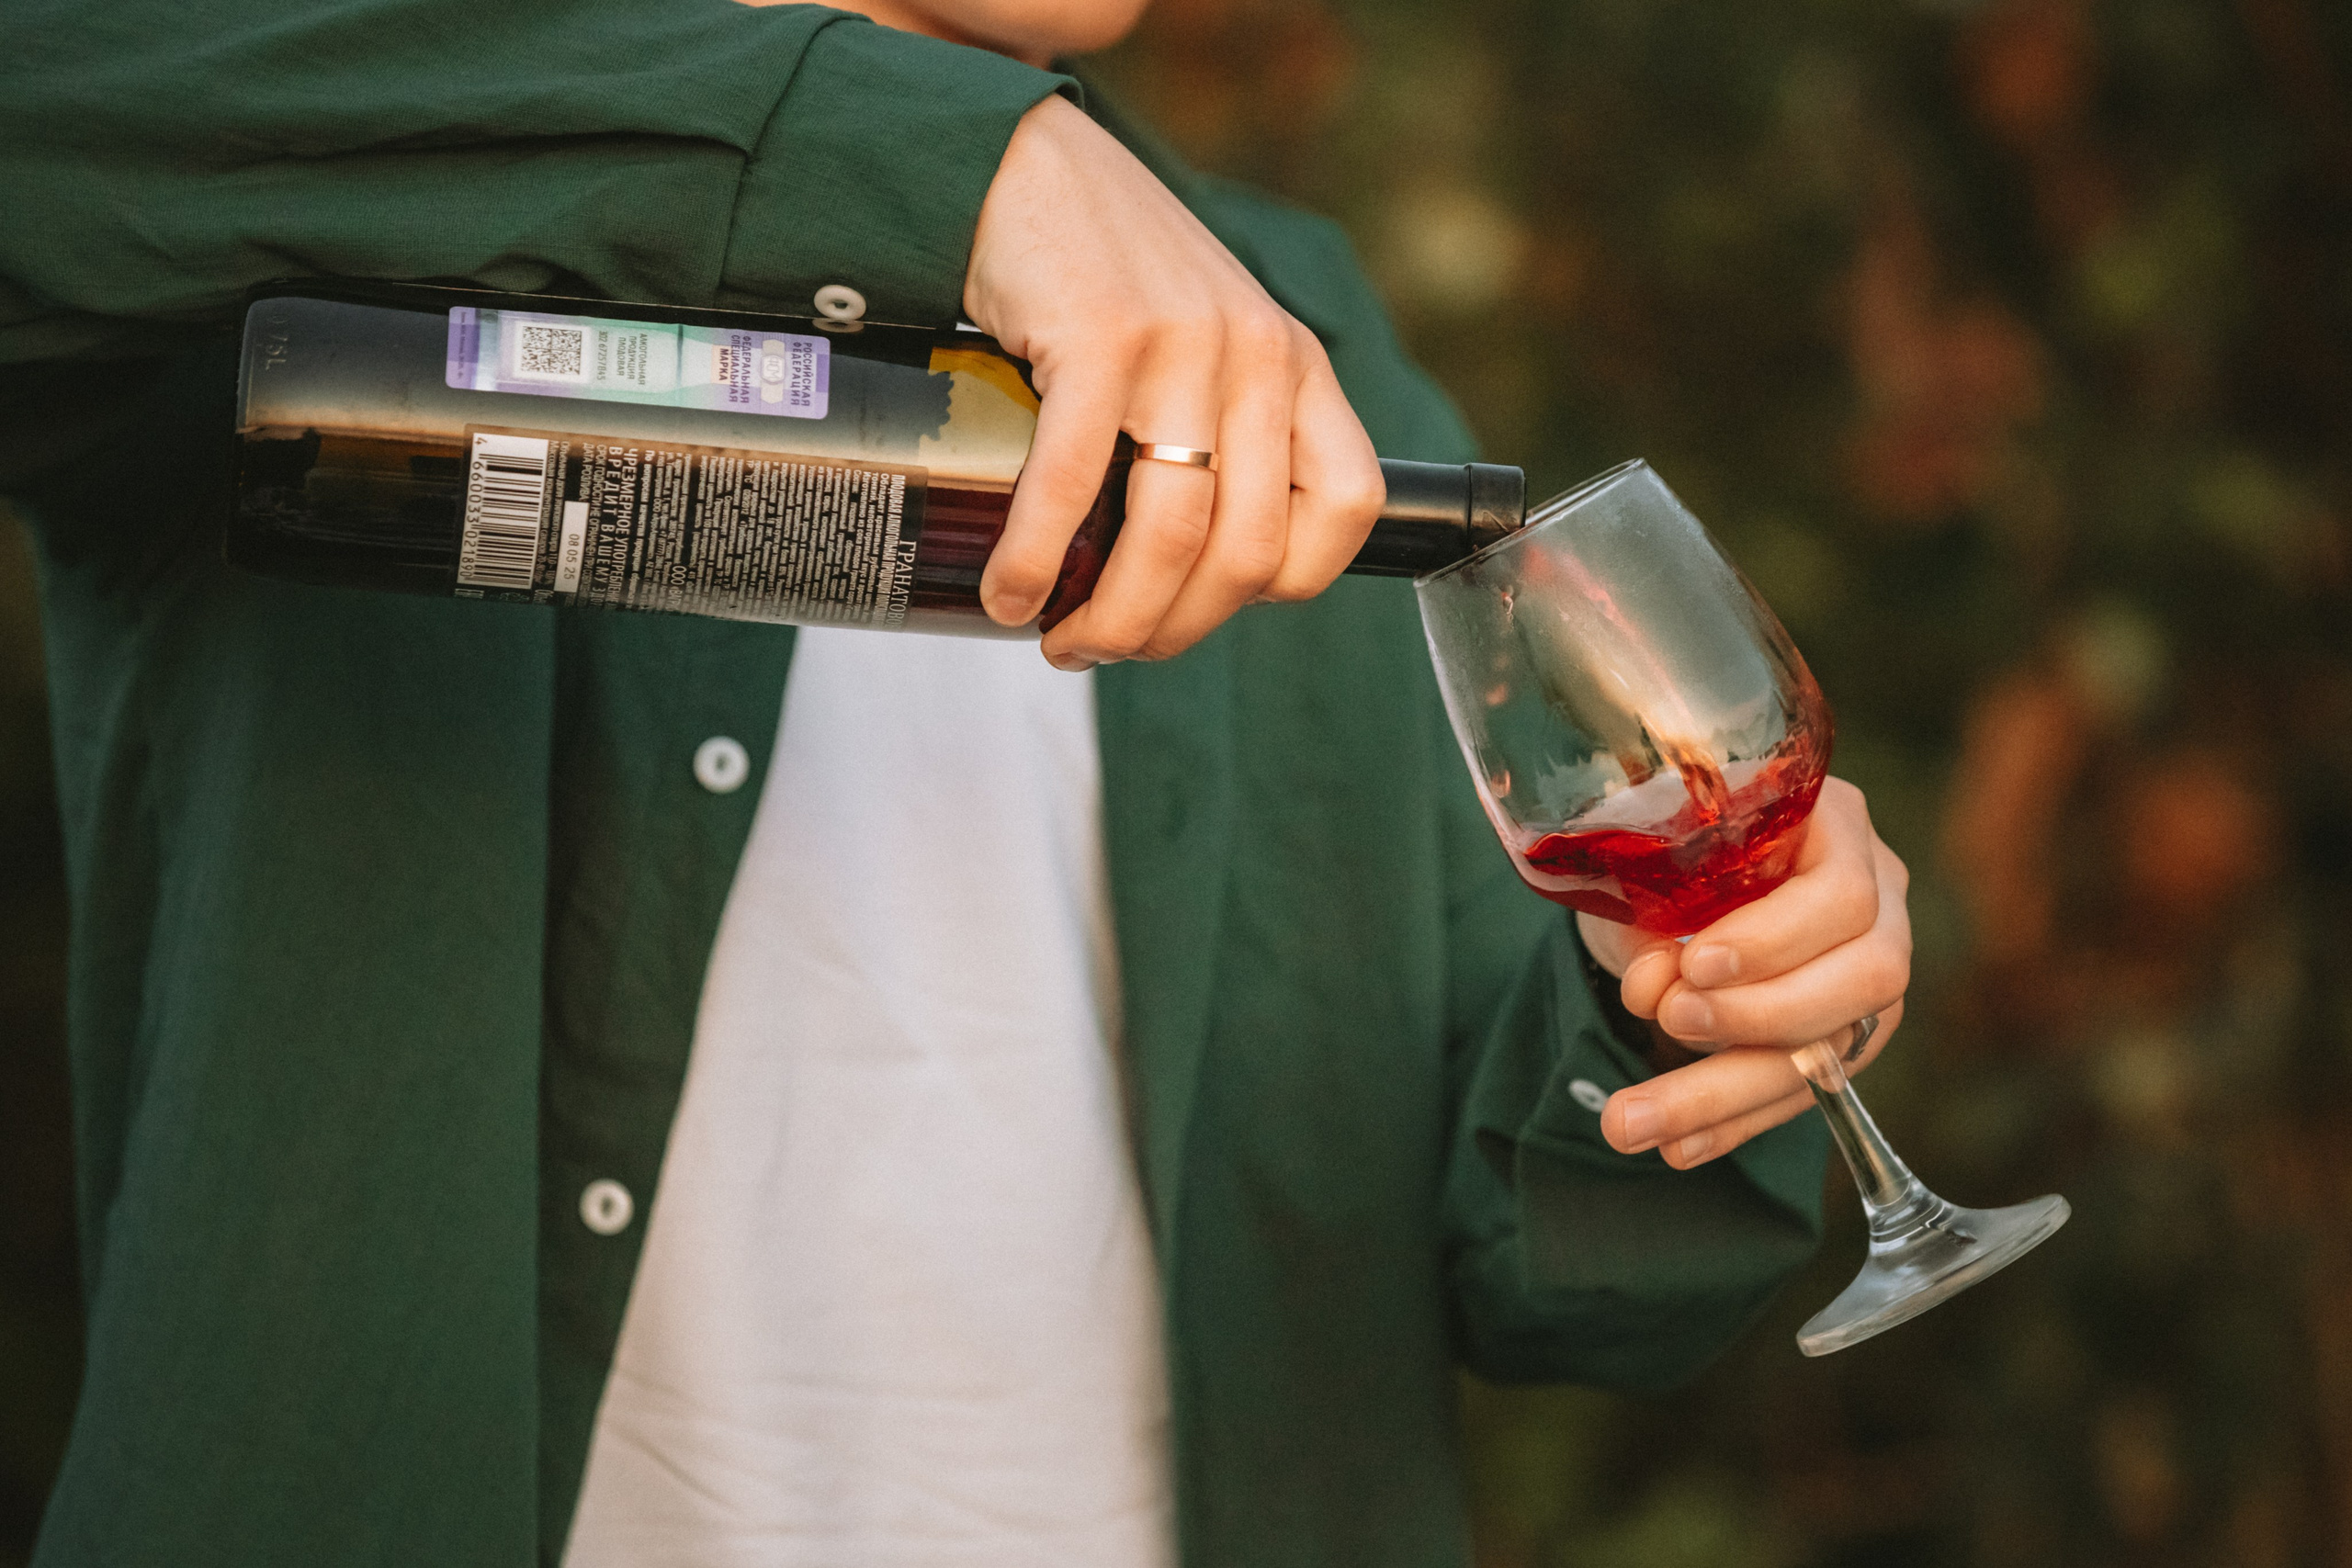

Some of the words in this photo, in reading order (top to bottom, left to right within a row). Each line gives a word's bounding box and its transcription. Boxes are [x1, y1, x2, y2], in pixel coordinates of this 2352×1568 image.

[616, 336, 626, 376] ПЛОДОВАЯ
[627, 335, 636, 379] ПРОДУКЦИЯ
[638, 333, 647, 385] АЛКОГОЛЬНАЯ
[718, 348, 728, 380] МАРКА
[728, 334, 740, 402] СПЕЦИАЛЬНАЯ
[740, 335, 751, 403] ФЕДЕРАЛЬНАЯ
[789, 342, 801, 405] ФЕДЕРАЦИЯ
[800, 342, 813, 406] РОССИЙСКАЯ
[581, 442, 594, 463] ДАТА
[595, 444, 606, 465] СРОК
[644, 449, 654, 461] По
[745, 459, 753, 468] ТР
[468, 460, 485, 523] 660033
[591, 466, 604, 505] ГОДНОСТИ
[603, 446, 621, 513] ВРЕДИТ
[616, 447, 636, 535] ЧРЕЗМЕРНОЕ
[640, 463, 650, 502] вопросам
[743, 473, 752, 482] ТС
[860, 471, 870, 517] Изготовлено
[868, 472, 878, 502] тонкий,
[876, 473, 888, 513] Обладает
[885, 474, 904, 513] ПЛОДОВАЯ
[590, 506, 601, 516] НЕ
[638, 504, 647, 536] качества
[858, 518, 865, 526] из
[585, 517, 599, 555] ОГРАНИЧЕН
[862, 504, 876, 560] неповторимый
[872, 514, 883, 555] красивым
[882, 513, 901, 560] АЛКОГОЛЬНАЯ
[458, 529, 479, 577] 021890
[593, 523, 615, 582] ВАШЕМУ
[605, 536, 628, 602] УПОТРЕБЛЕНИЕ
[630, 537, 643, 570] продукции
[853, 545, 862, 568] плодов
[859, 562, 867, 577] вкус
[865, 557, 878, 592] рубиновым
[876, 560, 894, 592] ПРОДУКЦИЯ
